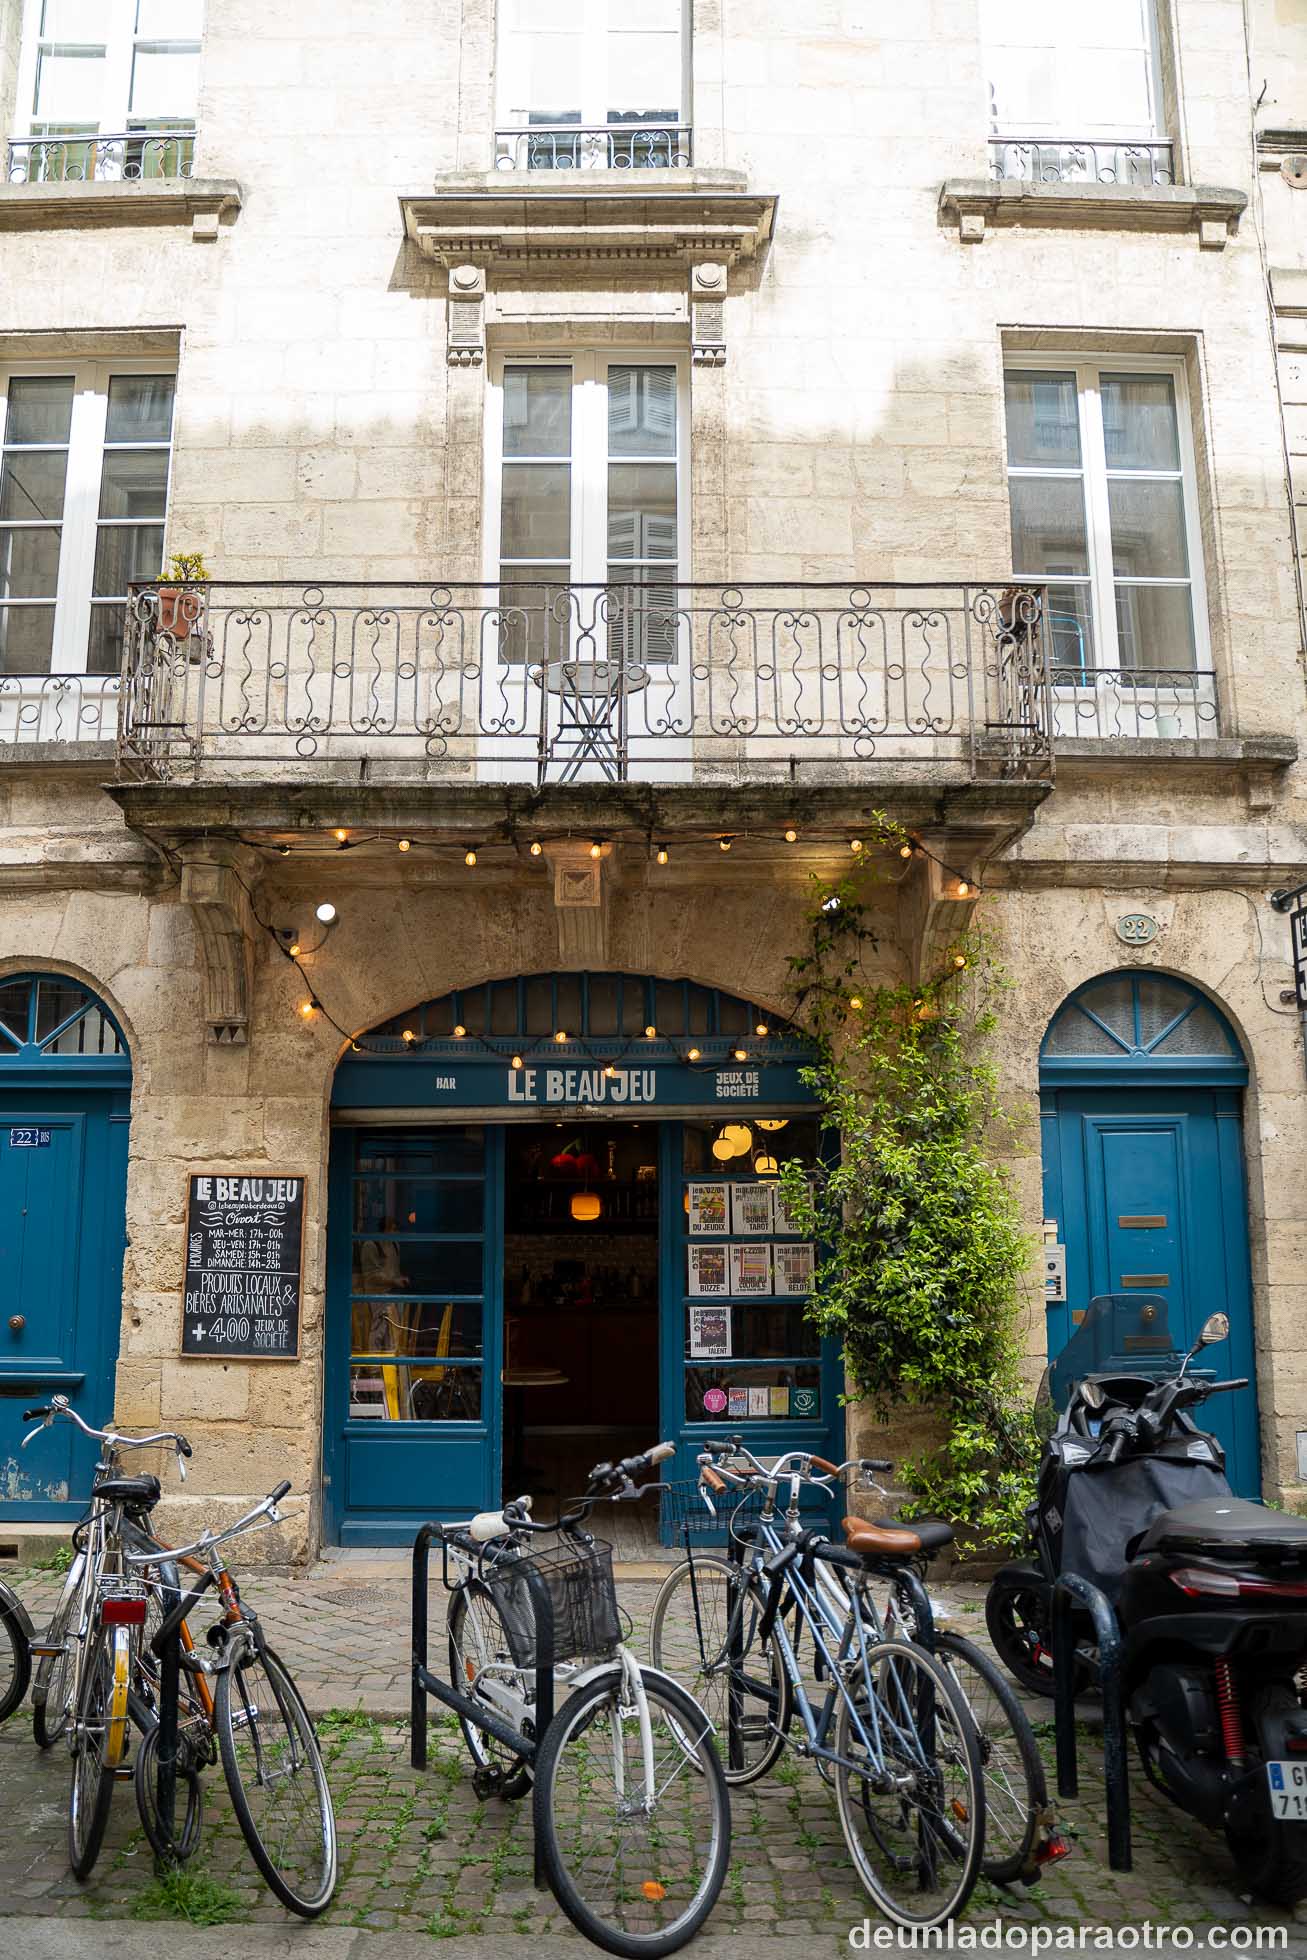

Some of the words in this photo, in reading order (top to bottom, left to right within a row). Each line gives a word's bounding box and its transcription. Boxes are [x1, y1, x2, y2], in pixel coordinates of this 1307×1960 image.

[1125, 920, 1149, 938] 22
[436, 1077, 456, 1089] BAR
[508, 1070, 536, 1101] LE
[546, 1070, 606, 1101] BEAU
[611, 1070, 656, 1101] JEU
[716, 1072, 743, 1084] JEUX
[746, 1072, 759, 1084] DE
[716, 1083, 759, 1096] SOCIÉTÉ
[16, 1131, 32, 1144] 22
[197, 1178, 212, 1200] LE
[216, 1178, 263, 1202] BEAU
[265, 1180, 298, 1202] JEU
[226, 1212, 262, 1225] Ouvert
[692, 1224, 702, 1232] DU
[189, 1232, 203, 1268] HORAIRES
[201, 1272, 242, 1294] PRODUITS
[245, 1274, 282, 1296] LOCAUX
[220, 1294, 283, 1316] ARTISANALES
[254, 1319, 275, 1332] JEUX
[278, 1319, 289, 1332] DE
[1292, 1767, 1307, 1786] G
[1279, 1795, 1307, 1816] 71
